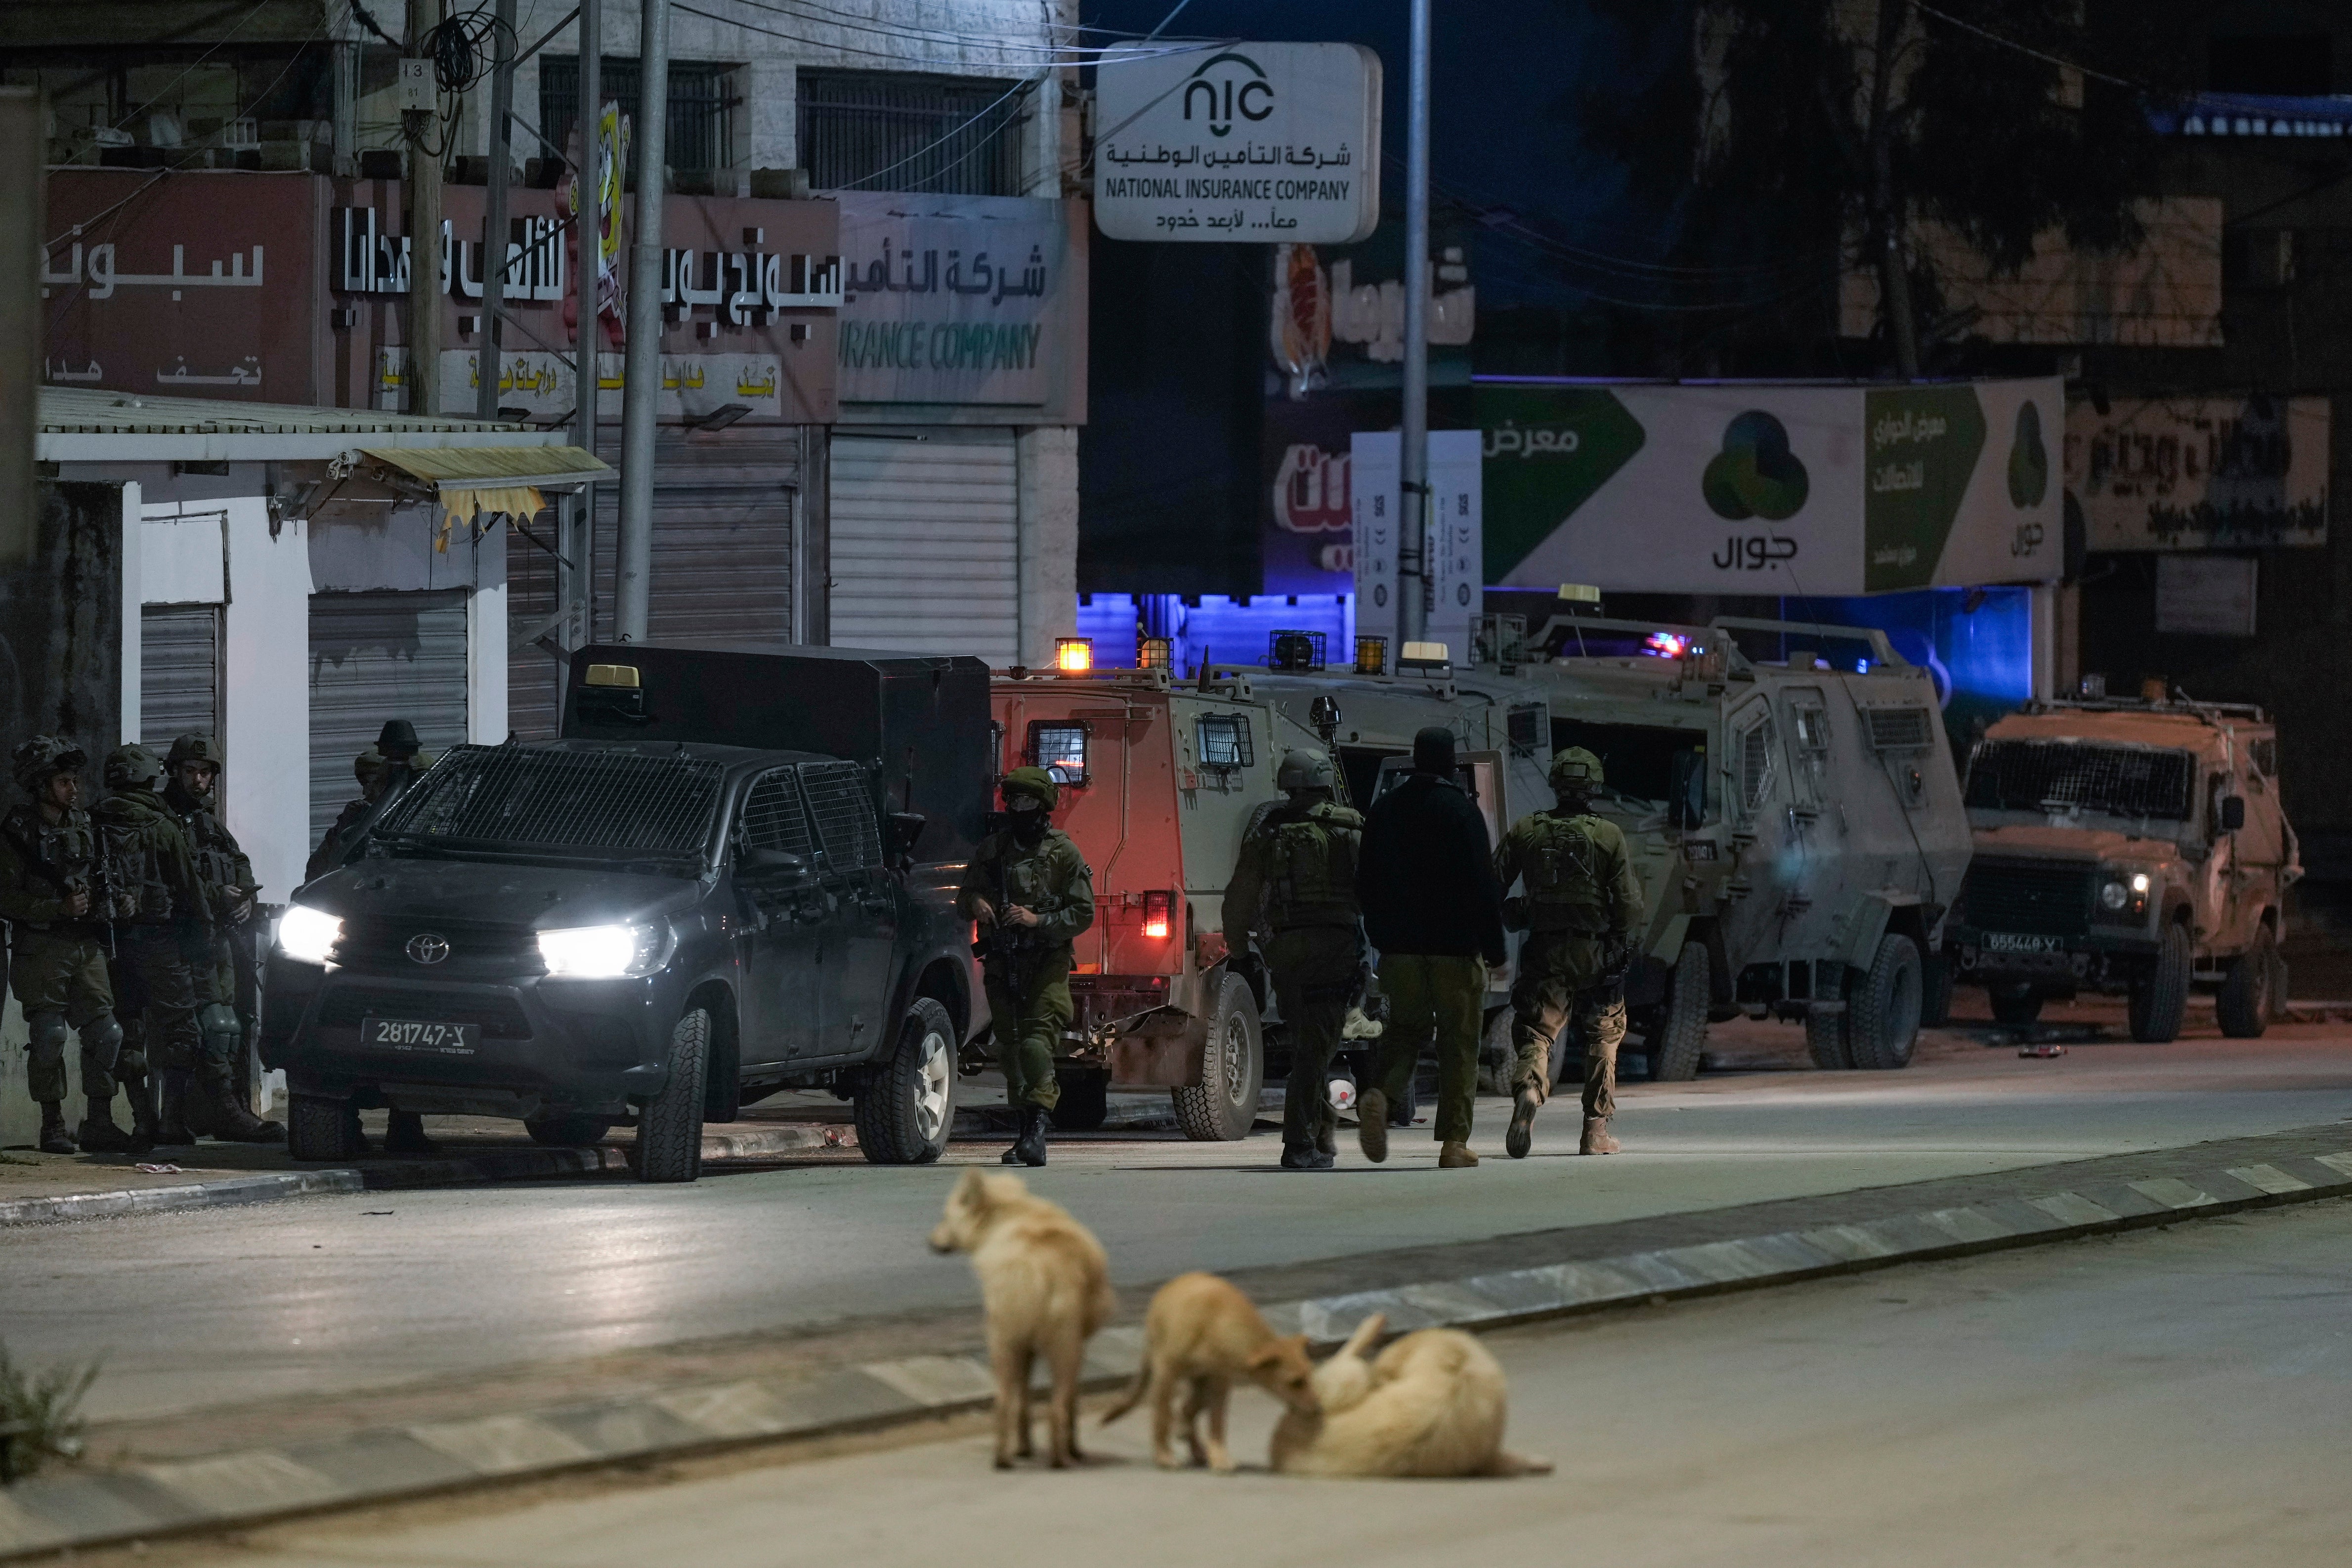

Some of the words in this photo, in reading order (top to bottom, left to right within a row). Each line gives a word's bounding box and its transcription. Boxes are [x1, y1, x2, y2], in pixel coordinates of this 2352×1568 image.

[1106, 143, 1199, 169] الوطنية
[1203, 141, 1281, 169] التأمين
[1285, 142, 1351, 170] شركة
[1106, 177, 1181, 199] NATIONAL
[1186, 178, 1272, 200] INSURANCE
[1276, 179, 1350, 201] COMPANY
[42, 225, 263, 300] سبون
[844, 237, 939, 302] التأمي
[946, 245, 1046, 306] شركة
[930, 323, 1041, 370] COMPANY
[157, 355, 262, 385] تحف
[1482, 419, 1580, 459] معرض
[1712, 536, 1798, 569] جوال
